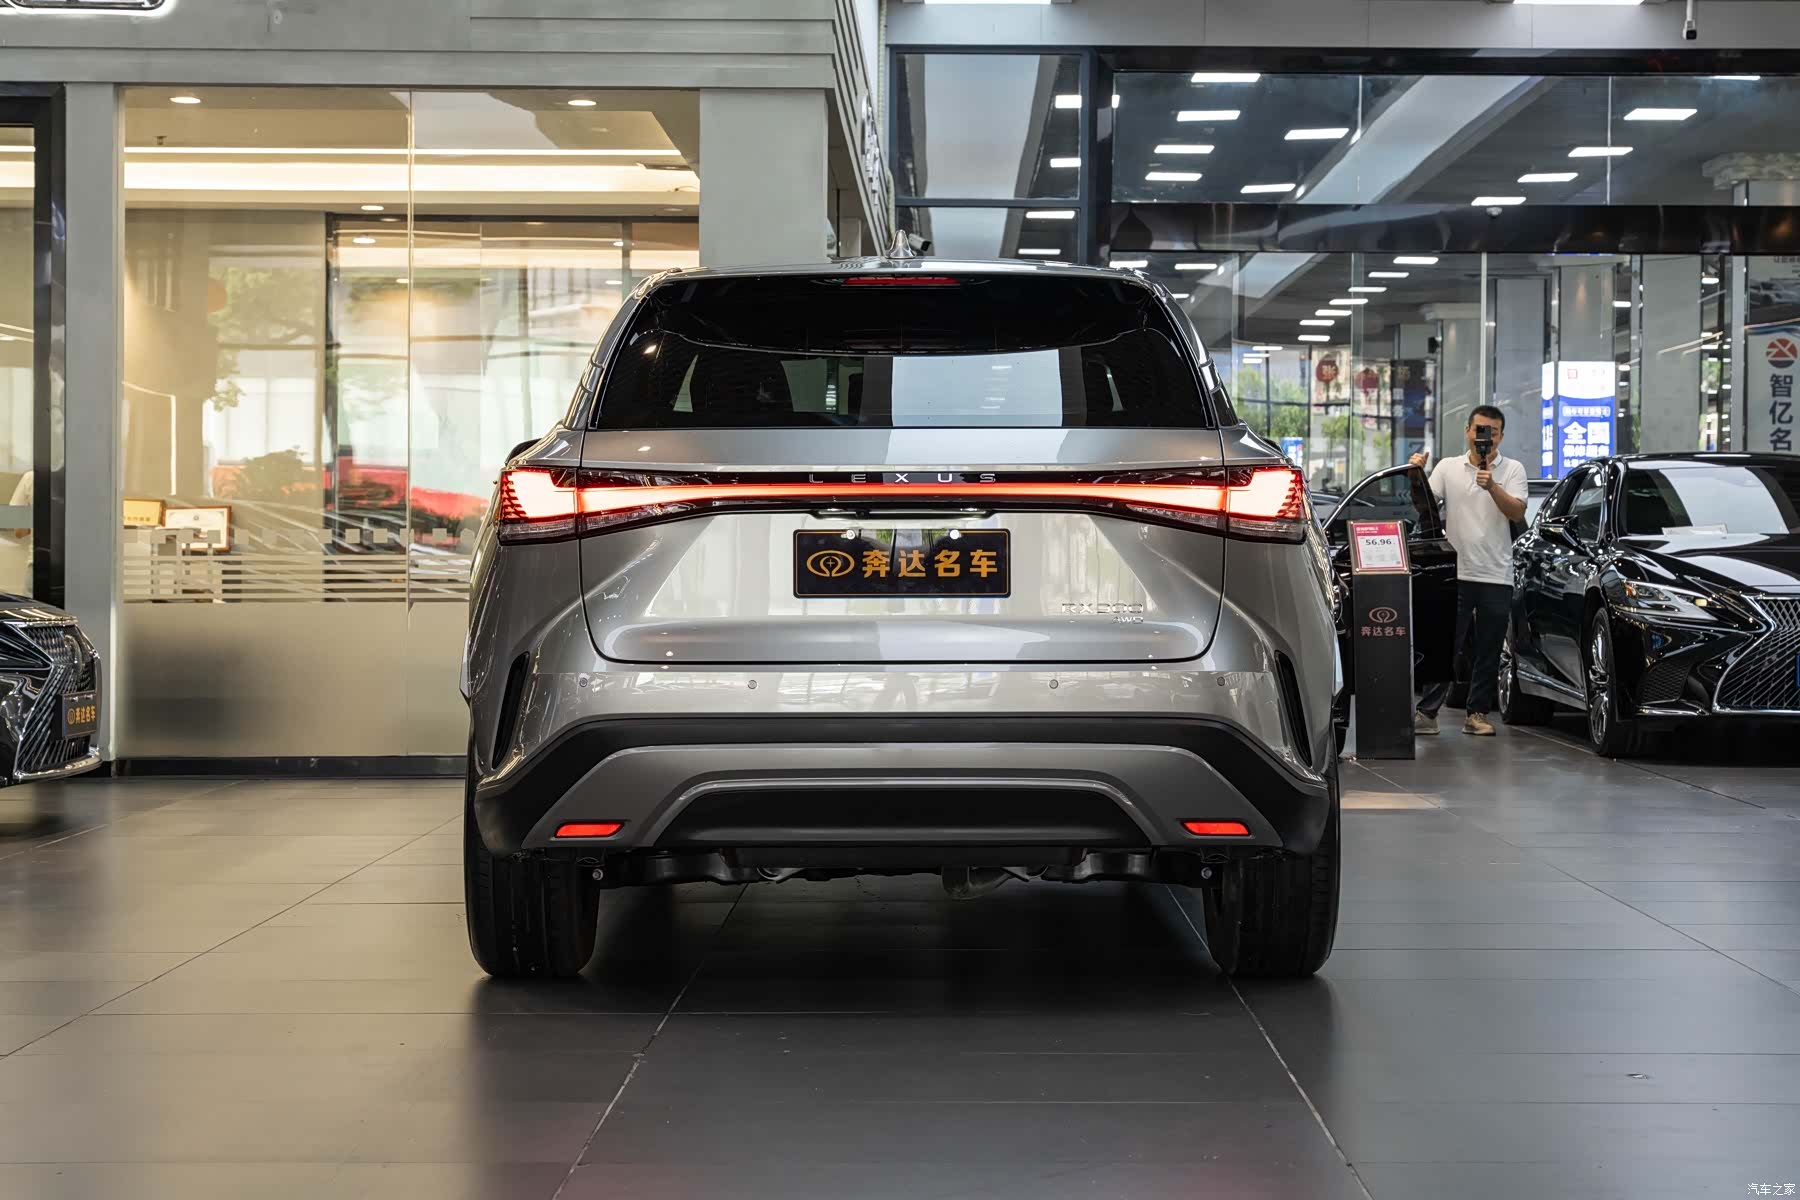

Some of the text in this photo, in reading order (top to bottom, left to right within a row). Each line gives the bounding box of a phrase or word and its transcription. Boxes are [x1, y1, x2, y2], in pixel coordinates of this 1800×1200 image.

[1769, 374, 1793, 451] 智亿名
[808, 473, 996, 483] LEXUS
[1365, 538, 1392, 546] 56.96
[862, 549, 998, 578] 奔达名车
[1361, 626, 1406, 637] 奔达名车
